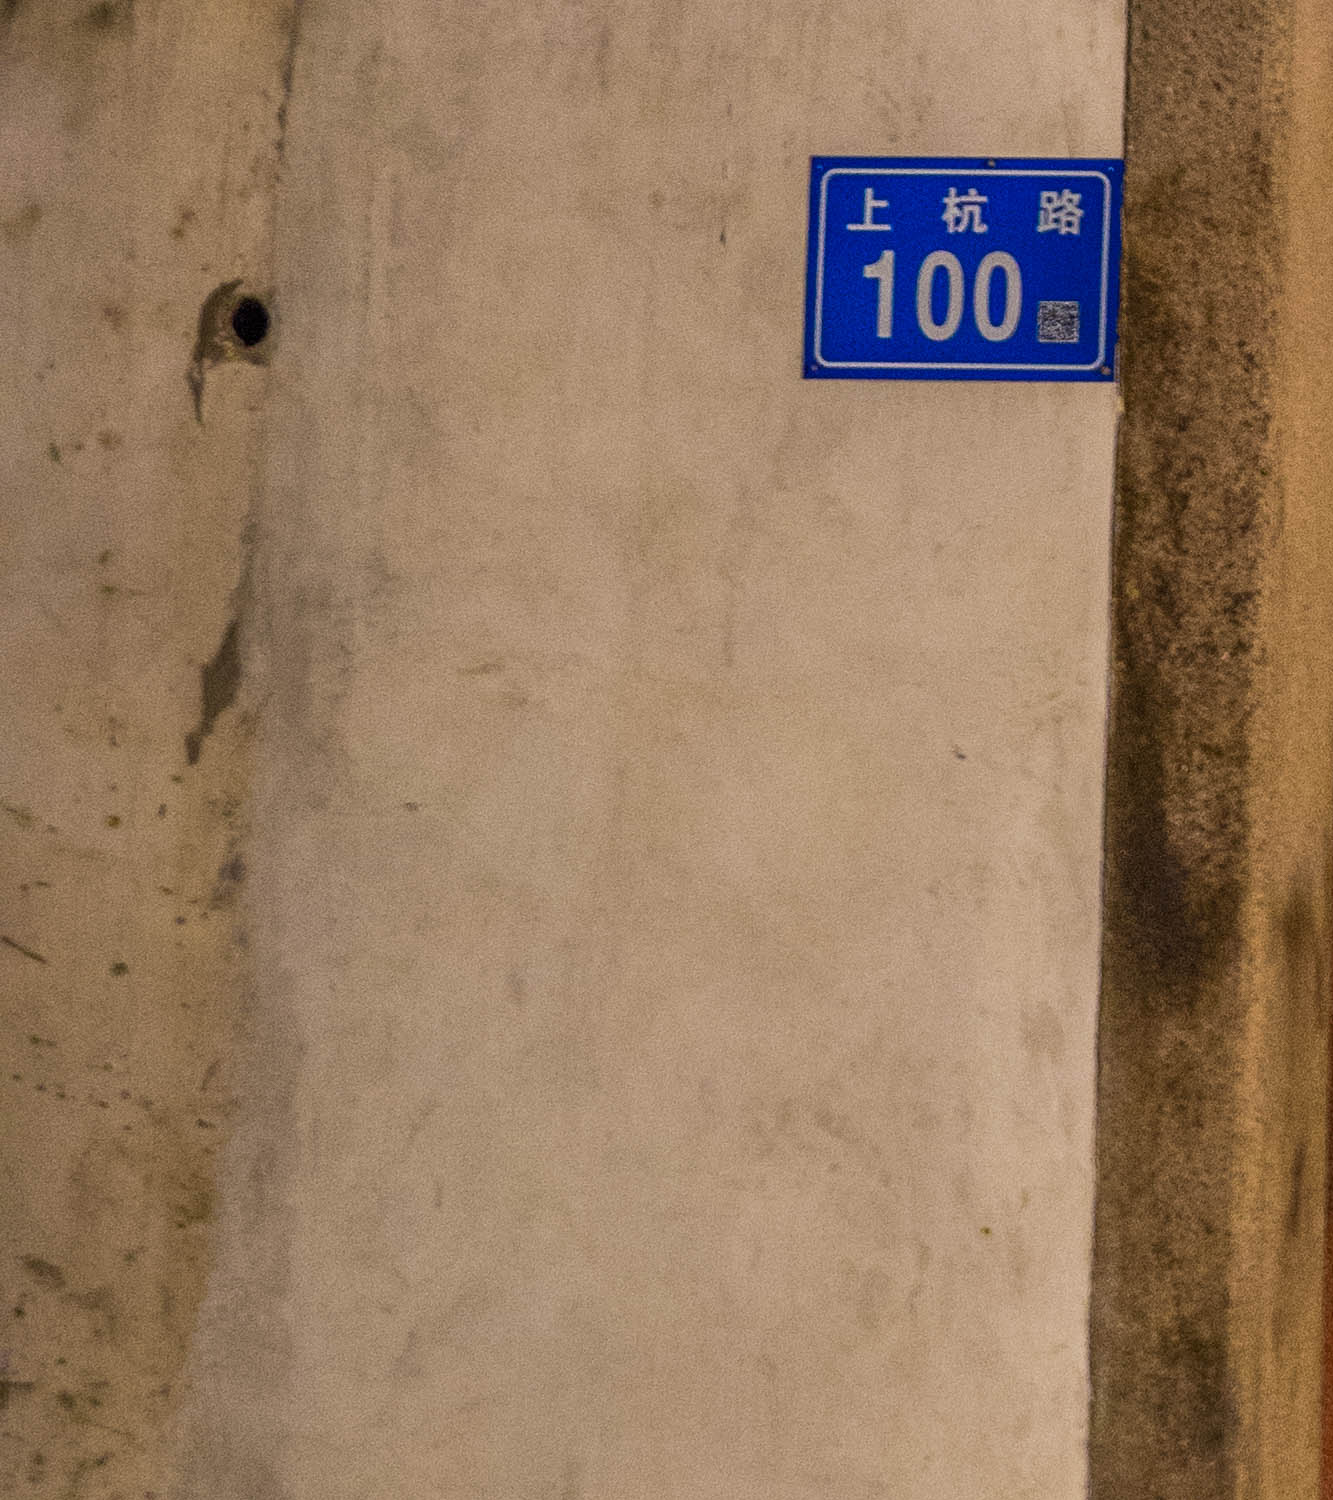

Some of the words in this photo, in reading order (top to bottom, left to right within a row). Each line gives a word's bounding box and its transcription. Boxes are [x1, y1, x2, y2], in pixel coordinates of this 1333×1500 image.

[846, 187, 1084, 235] 上杭路
[862, 249, 1023, 342] 100
